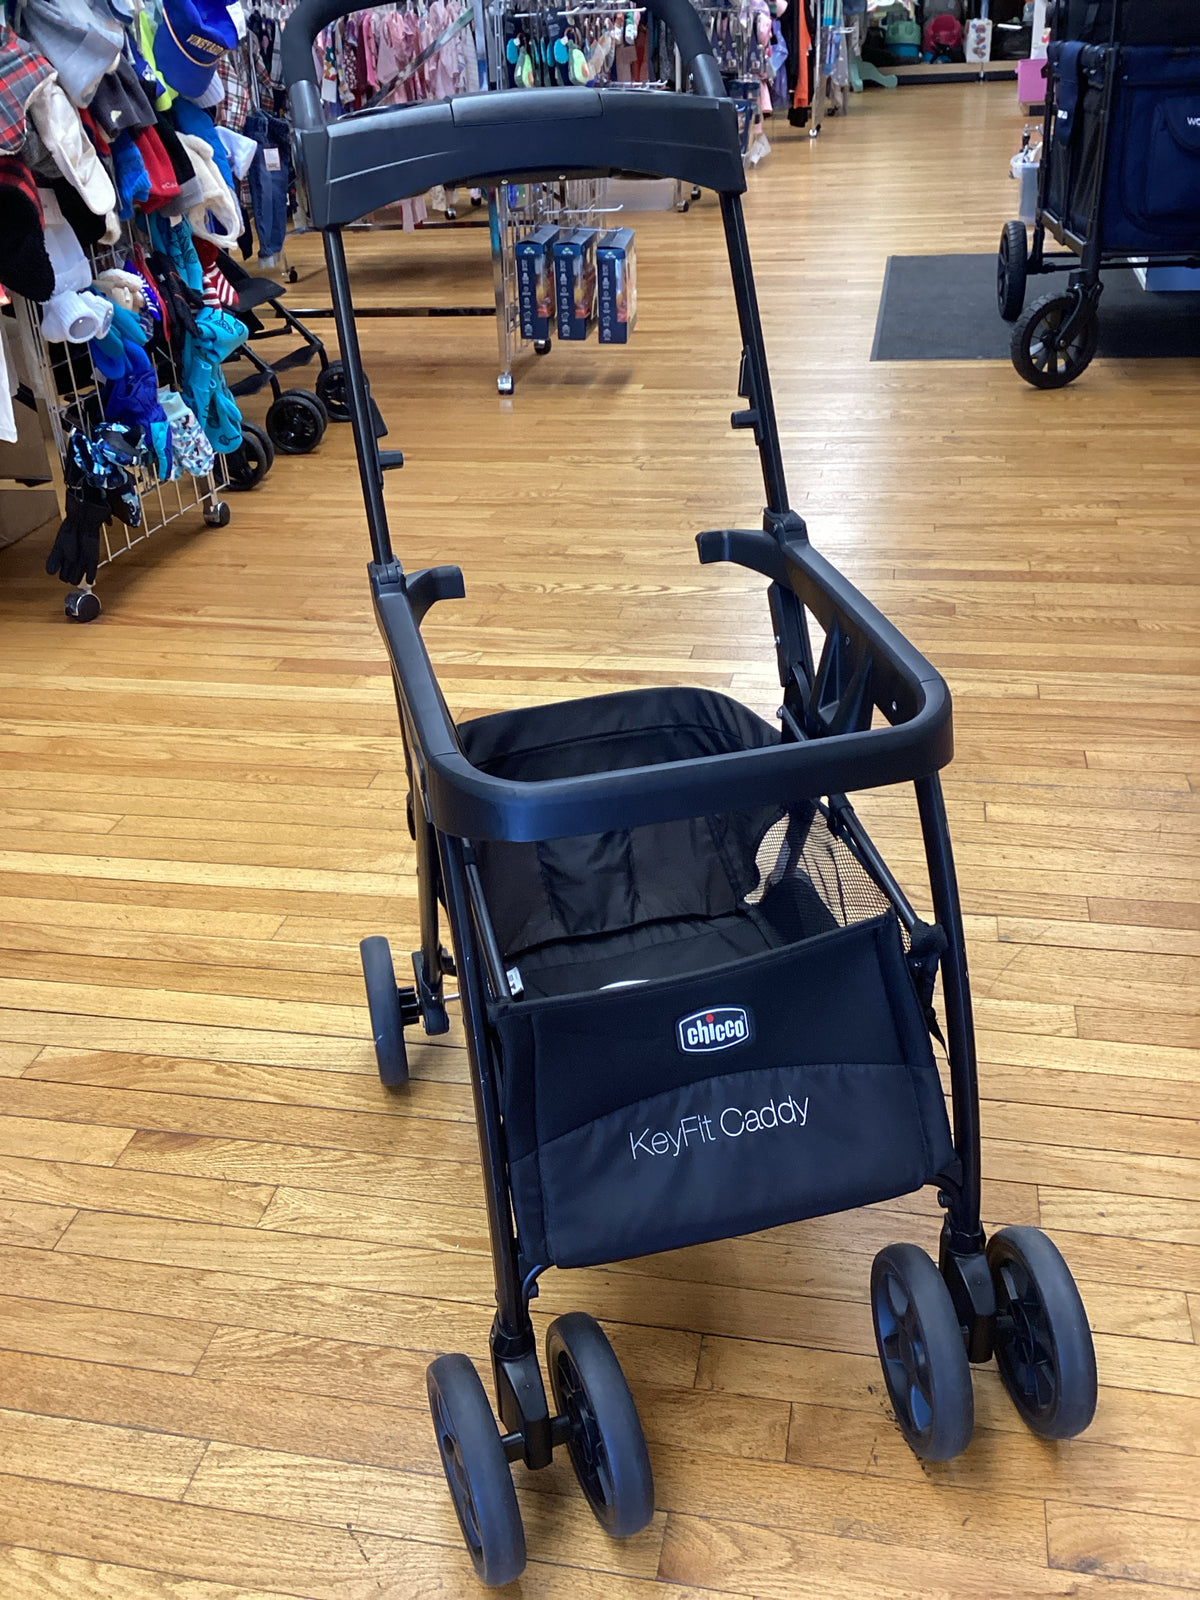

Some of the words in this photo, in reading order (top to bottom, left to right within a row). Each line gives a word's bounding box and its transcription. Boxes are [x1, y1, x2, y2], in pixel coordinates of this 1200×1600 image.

[686, 1013, 745, 1046] chicco
[629, 1114, 716, 1160] KeyFit
[720, 1095, 809, 1138] Caddy
